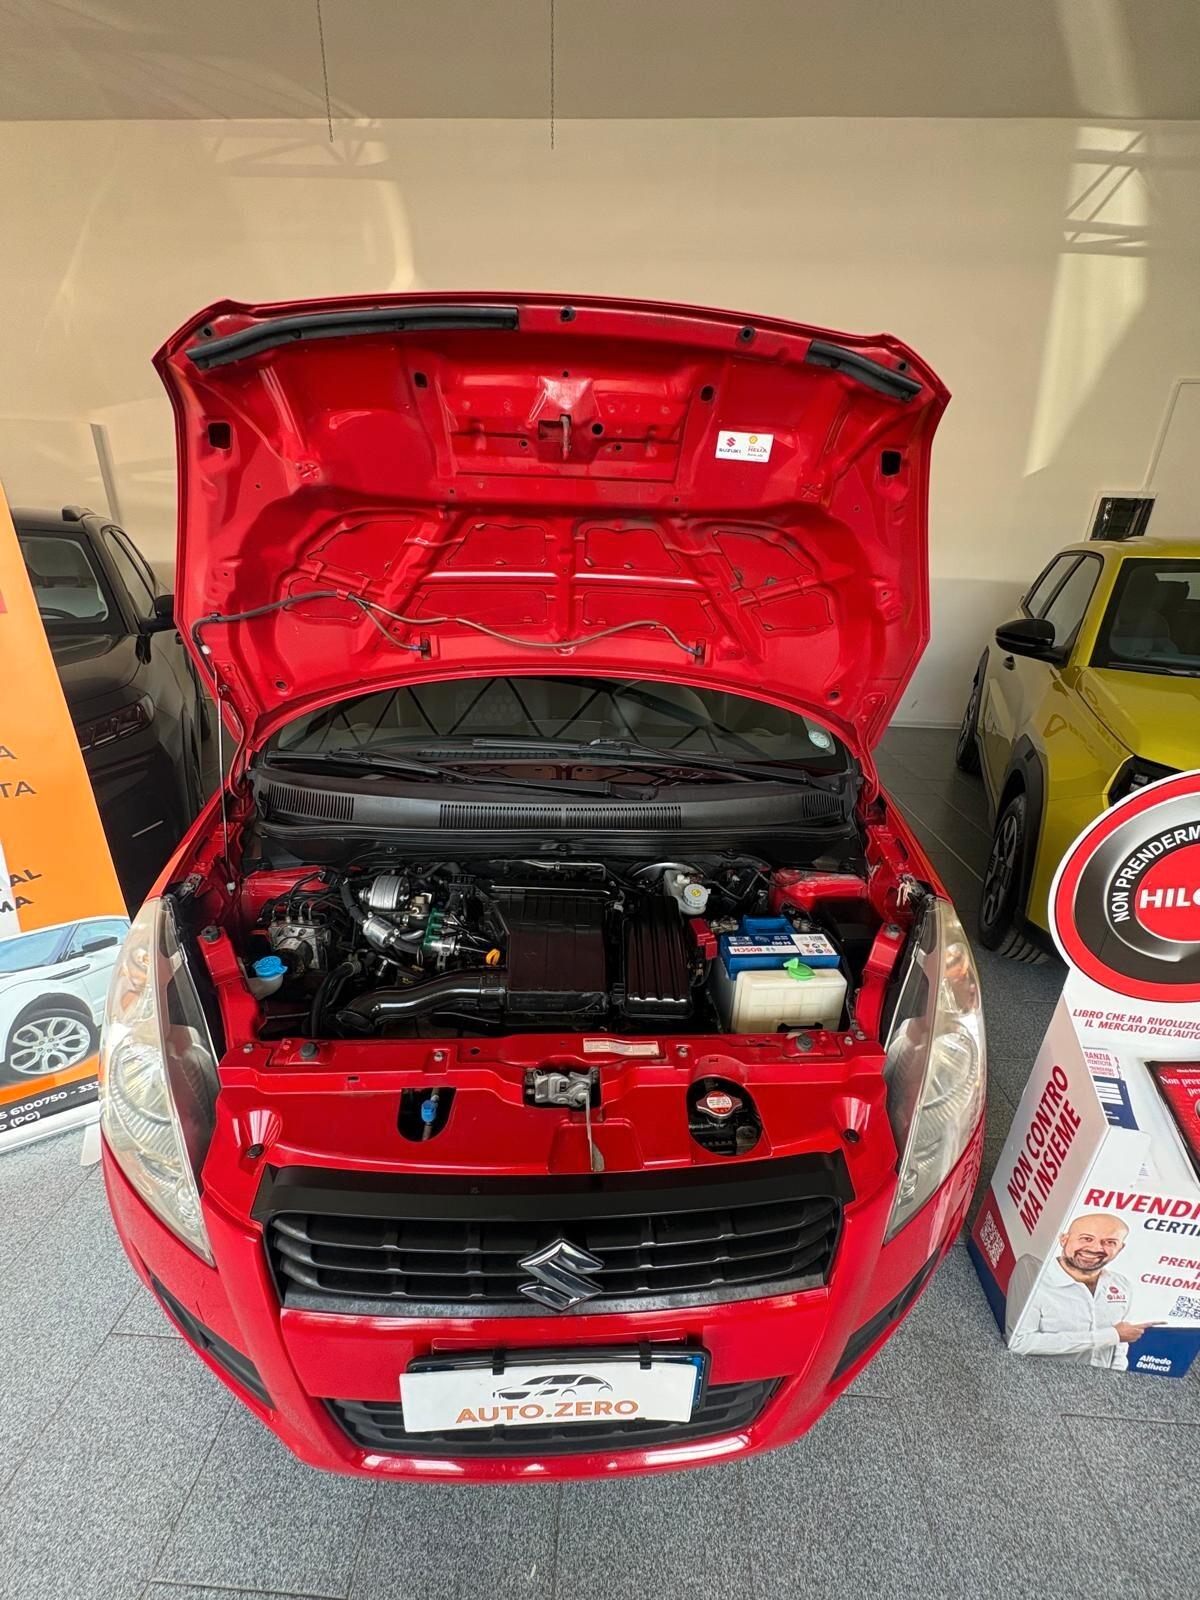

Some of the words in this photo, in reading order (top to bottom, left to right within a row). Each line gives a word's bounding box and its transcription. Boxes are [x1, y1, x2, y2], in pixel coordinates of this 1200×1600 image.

[1111, 891, 1130, 922] NON
[1073, 1008, 1103, 1019] LIBRO
[1105, 1012, 1126, 1022] CHE
[1127, 1015, 1143, 1024] HA
[1084, 1019, 1094, 1028] IL
[1097, 1021, 1147, 1034] MERCATO
[10, 1110, 41, 1128] (PC)
[1006, 1150, 1034, 1208] NON
[1025, 1065, 1069, 1161] CONTRO
[1019, 1188, 1044, 1237] MA
[1033, 1099, 1082, 1202] INSIEME
[1135, 1361, 1171, 1372] Bellucci
[1138, 1354, 1172, 1365] Alfredo
[455, 1399, 639, 1424] AUTO.ZERO
